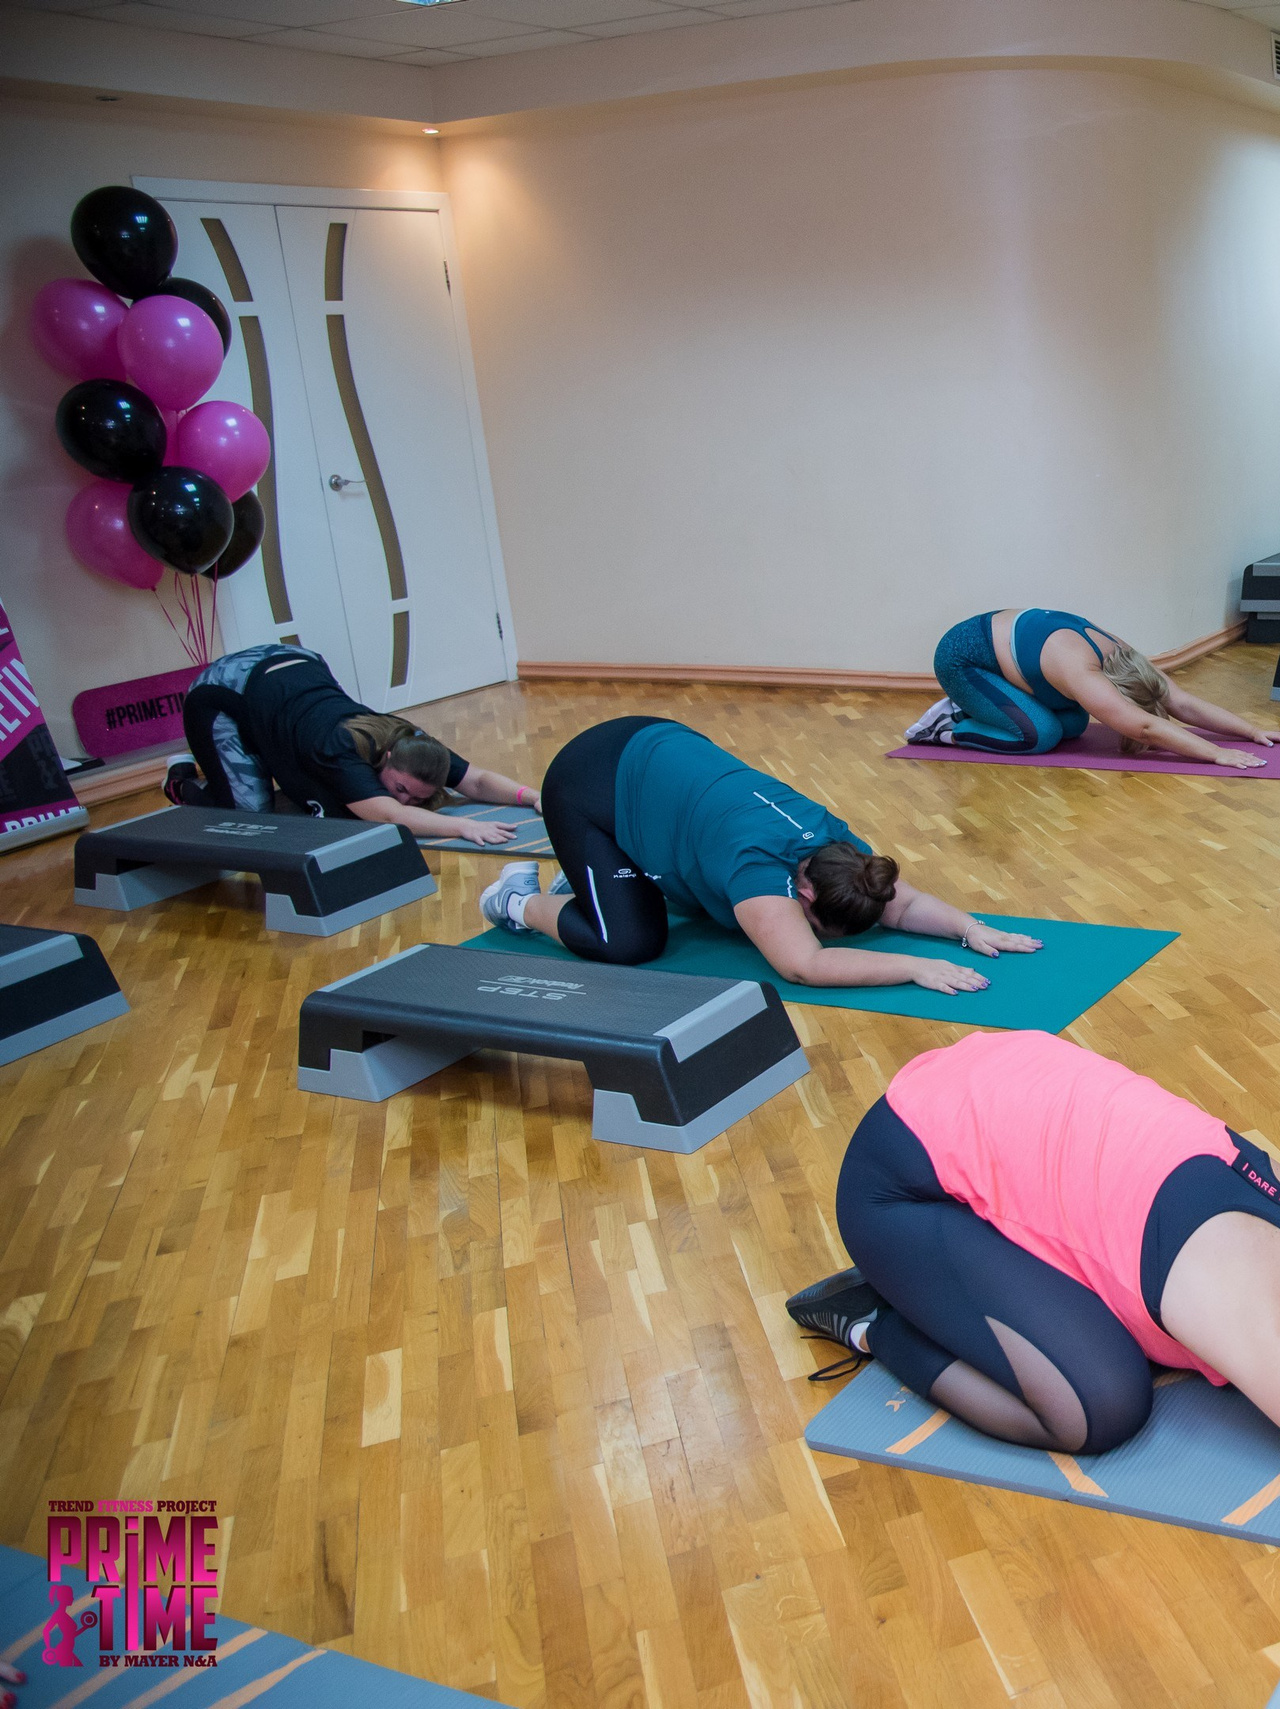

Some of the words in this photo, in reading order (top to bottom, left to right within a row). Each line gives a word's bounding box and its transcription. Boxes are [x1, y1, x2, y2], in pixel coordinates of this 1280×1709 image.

[477, 986, 567, 1001] STEP
[1242, 1162, 1249, 1172] I
[1248, 1170, 1278, 1196] DARE
